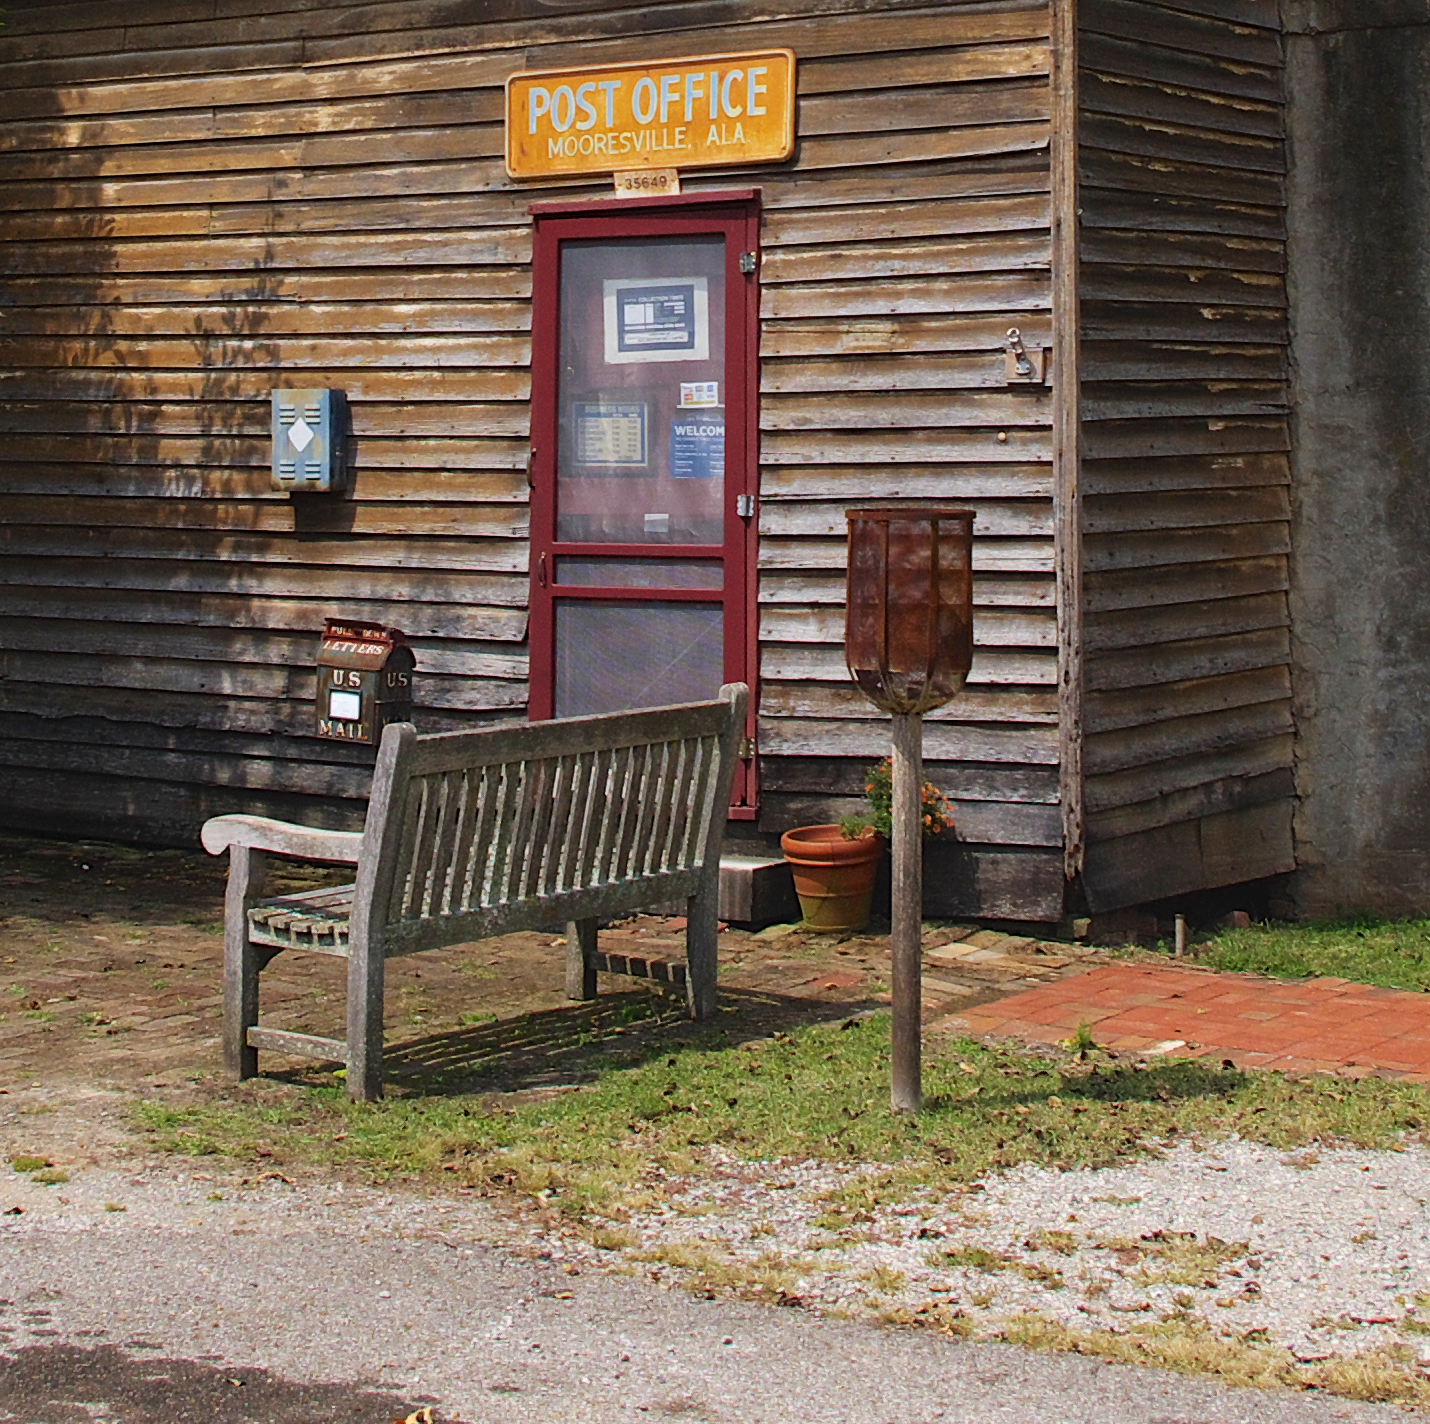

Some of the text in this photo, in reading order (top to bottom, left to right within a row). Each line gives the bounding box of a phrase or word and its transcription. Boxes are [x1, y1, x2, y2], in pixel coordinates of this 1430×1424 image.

[528, 66, 768, 135] POST OFFICE
[624, 175, 667, 190] 35649
[322, 640, 385, 655] LETTERS
[318, 719, 368, 741] MAIL
